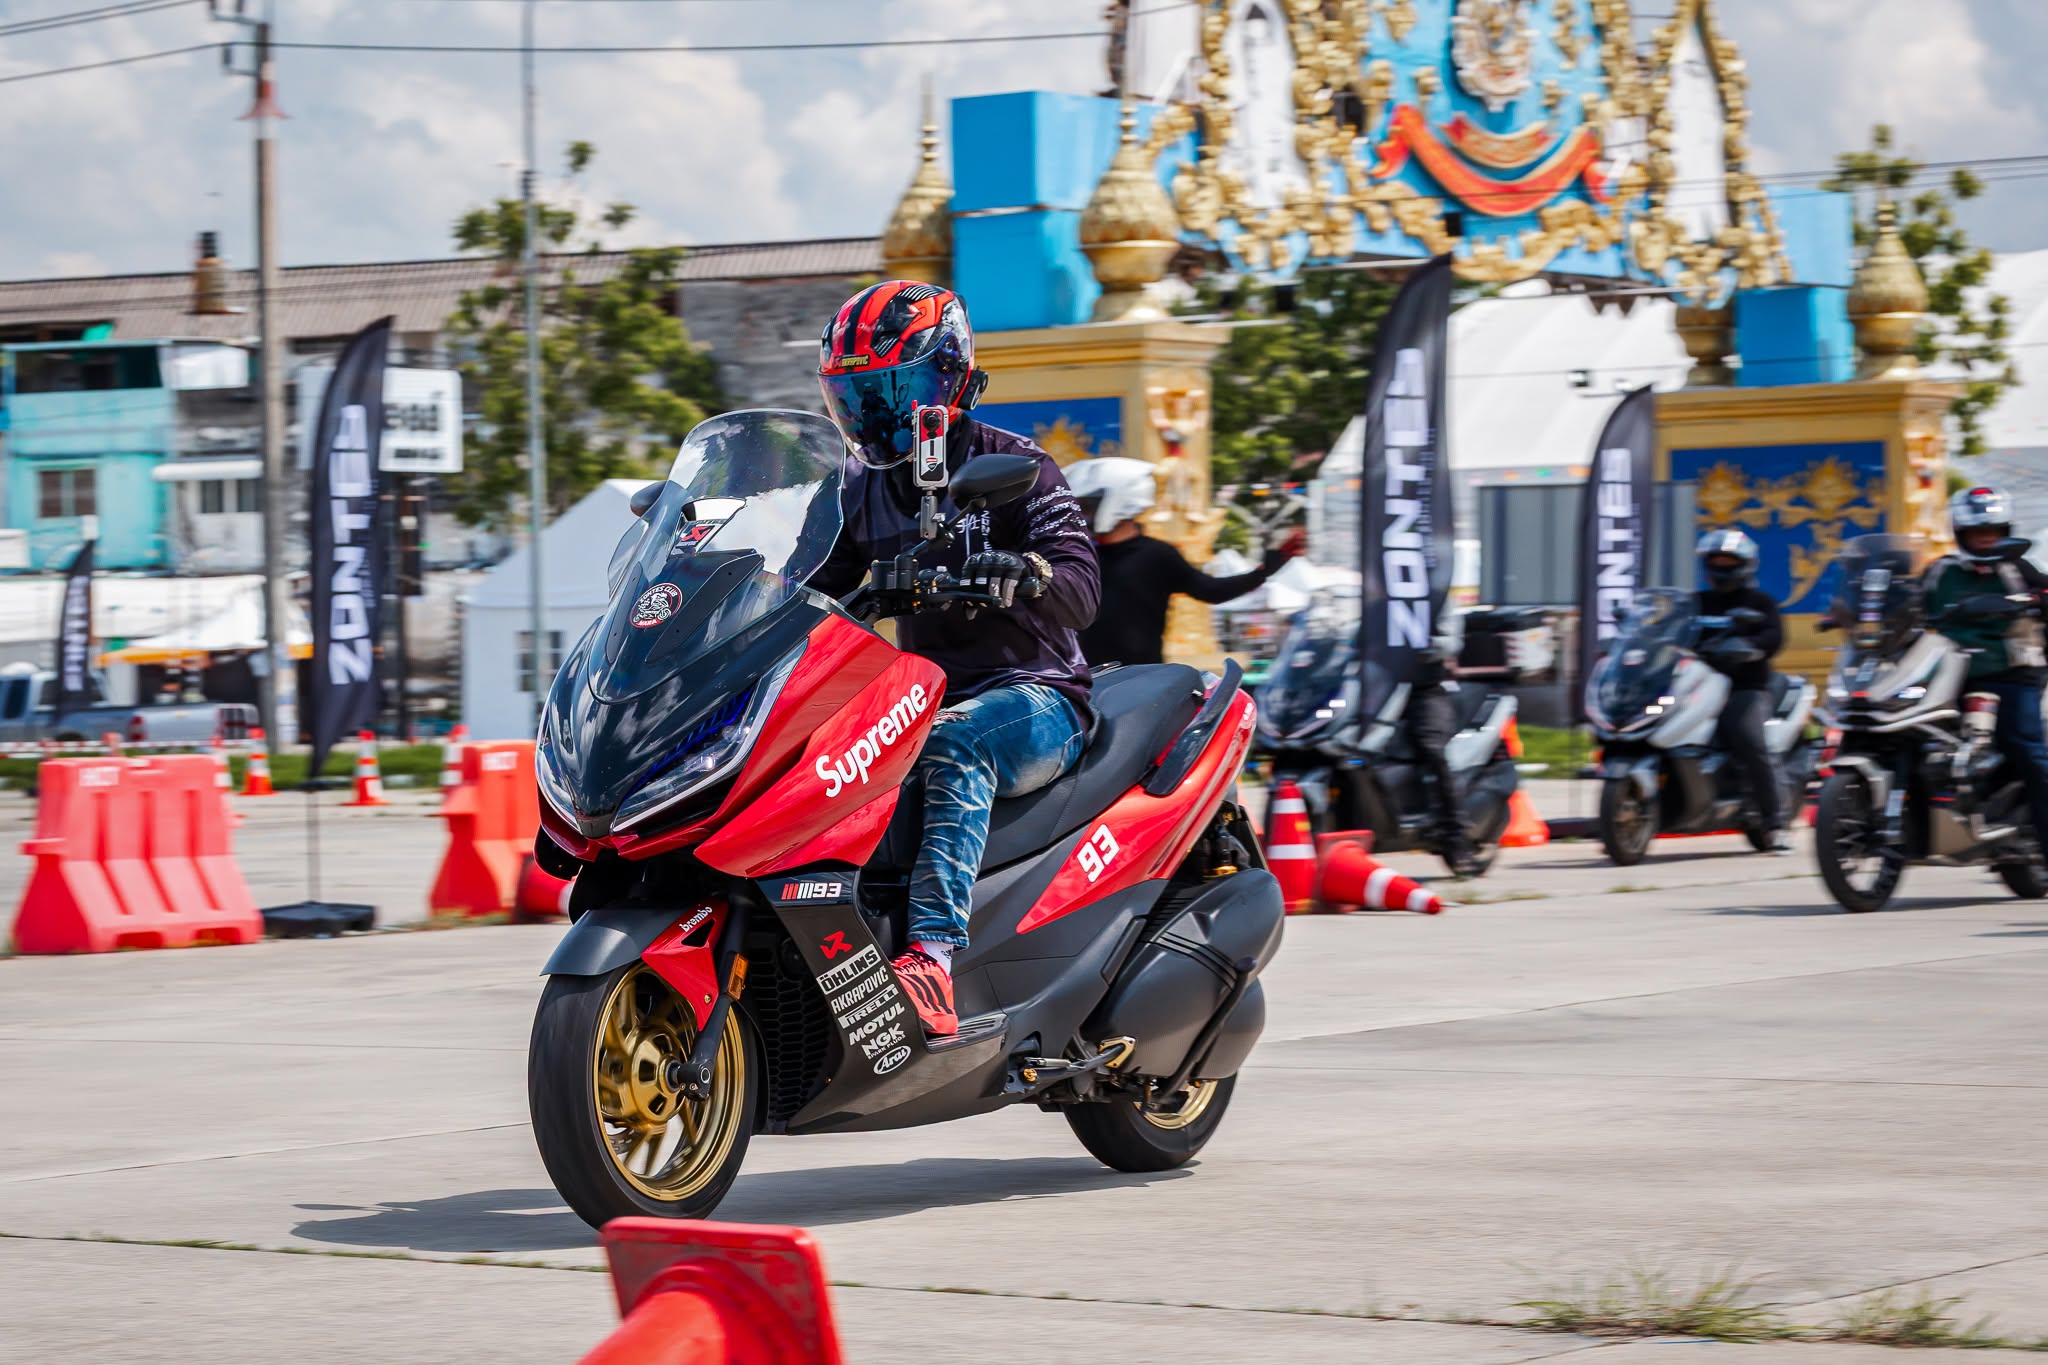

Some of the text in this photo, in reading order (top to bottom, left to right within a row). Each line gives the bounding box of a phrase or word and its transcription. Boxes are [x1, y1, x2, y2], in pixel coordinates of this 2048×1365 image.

[1382, 347, 1431, 648] ZONTES
[328, 404, 373, 686] ZONTES
[815, 683, 927, 798] Supreme
[1076, 823, 1121, 883] 93
[678, 906, 713, 932] brembo
[819, 949, 879, 992] ÖHLINS
[838, 983, 899, 1029] PIRELLI
[848, 1002, 905, 1046] MOTUL
[861, 1022, 904, 1057] NGK
[879, 1048, 907, 1073] Arai
